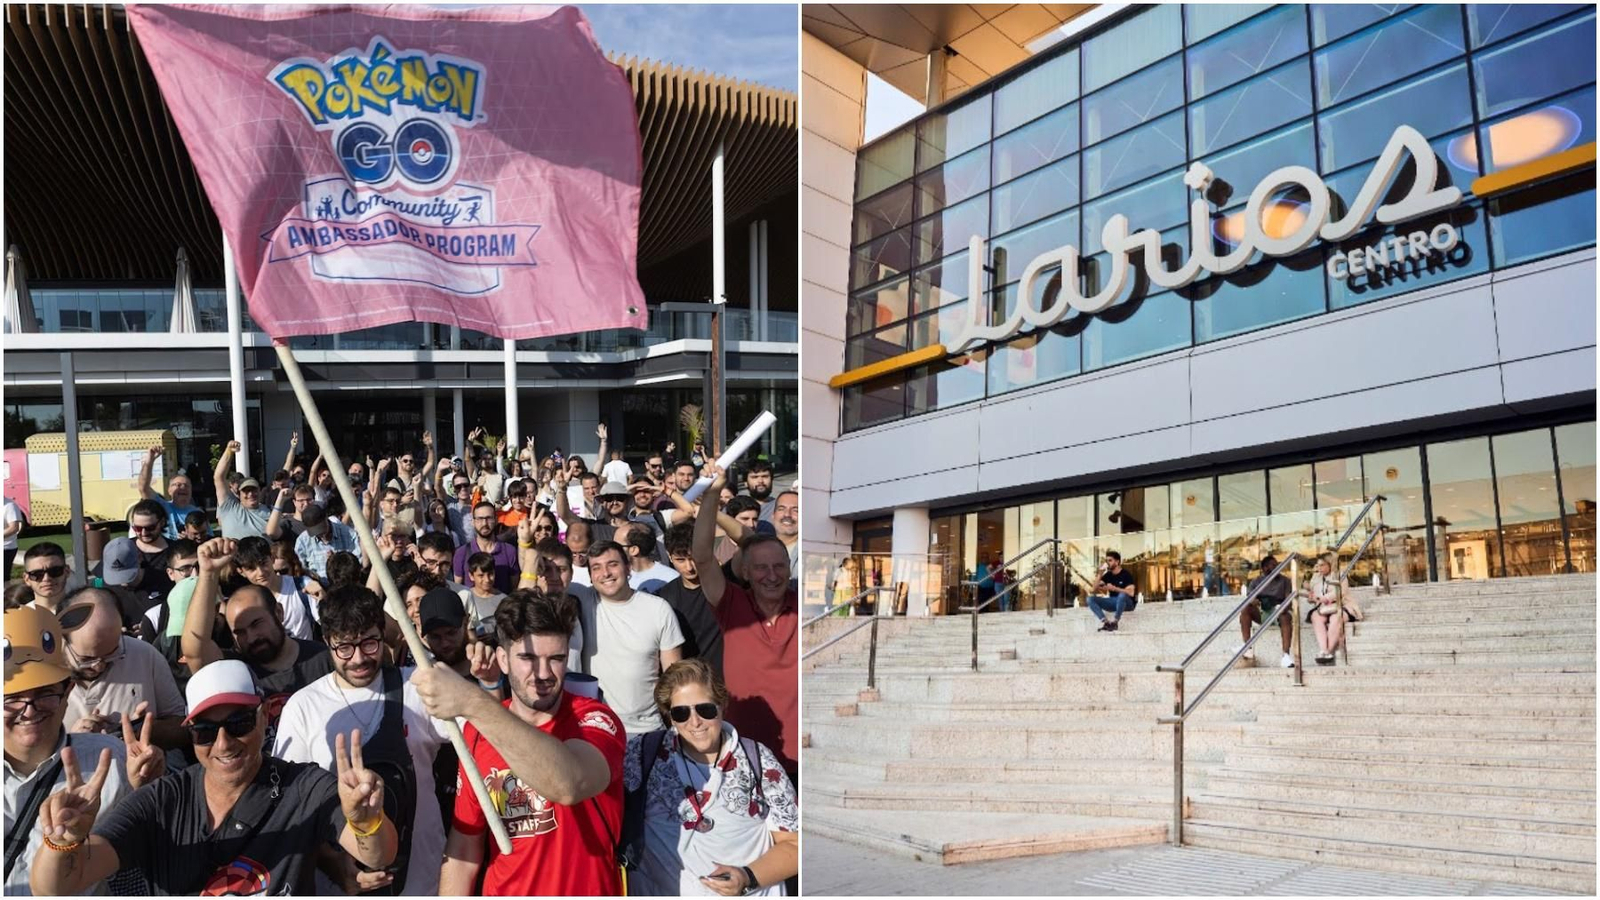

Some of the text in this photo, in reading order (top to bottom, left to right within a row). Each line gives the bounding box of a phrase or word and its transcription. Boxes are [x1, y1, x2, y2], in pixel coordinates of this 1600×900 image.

[337, 117, 454, 184] GO
[341, 188, 461, 225] Community
[287, 218, 517, 257] AMBASSADOR PROGRAM
[947, 124, 1463, 354] Larios
[1327, 222, 1459, 281] CENTRO
[508, 818, 540, 833] STAFF
